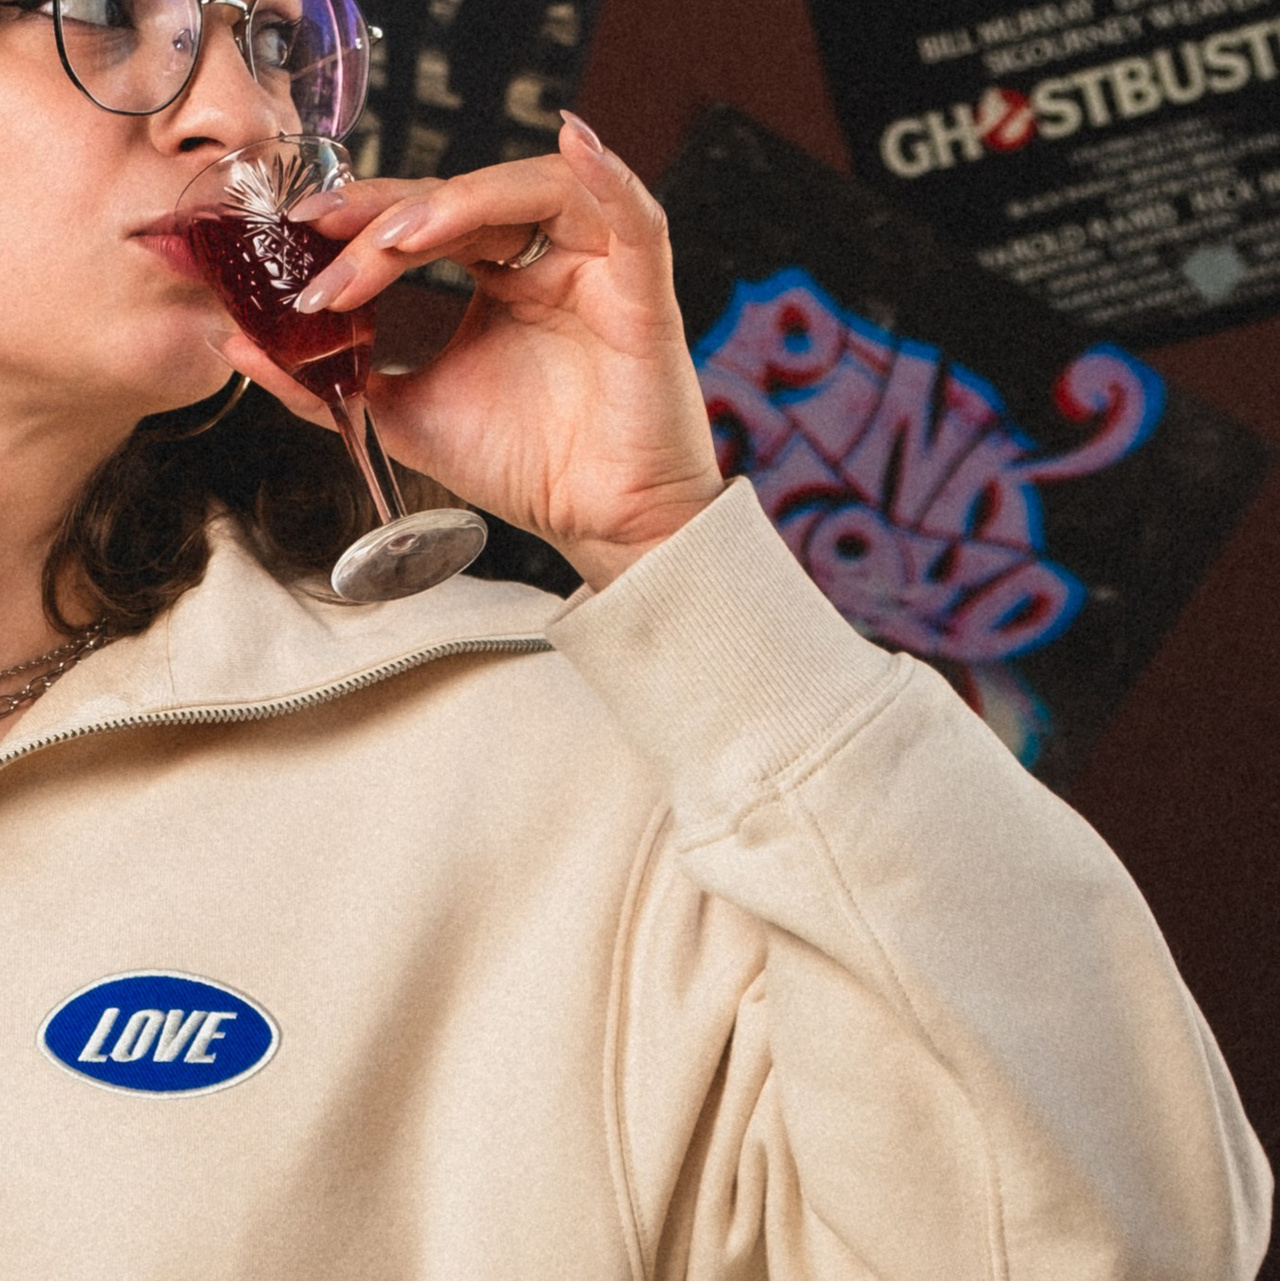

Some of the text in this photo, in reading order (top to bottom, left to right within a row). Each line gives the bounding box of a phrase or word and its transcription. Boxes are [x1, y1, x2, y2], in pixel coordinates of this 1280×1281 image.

[917, 27, 975, 65] BILL
[982, 15, 1143, 77] SIGOURNEY
[76, 1006, 239, 1064] LOVE
